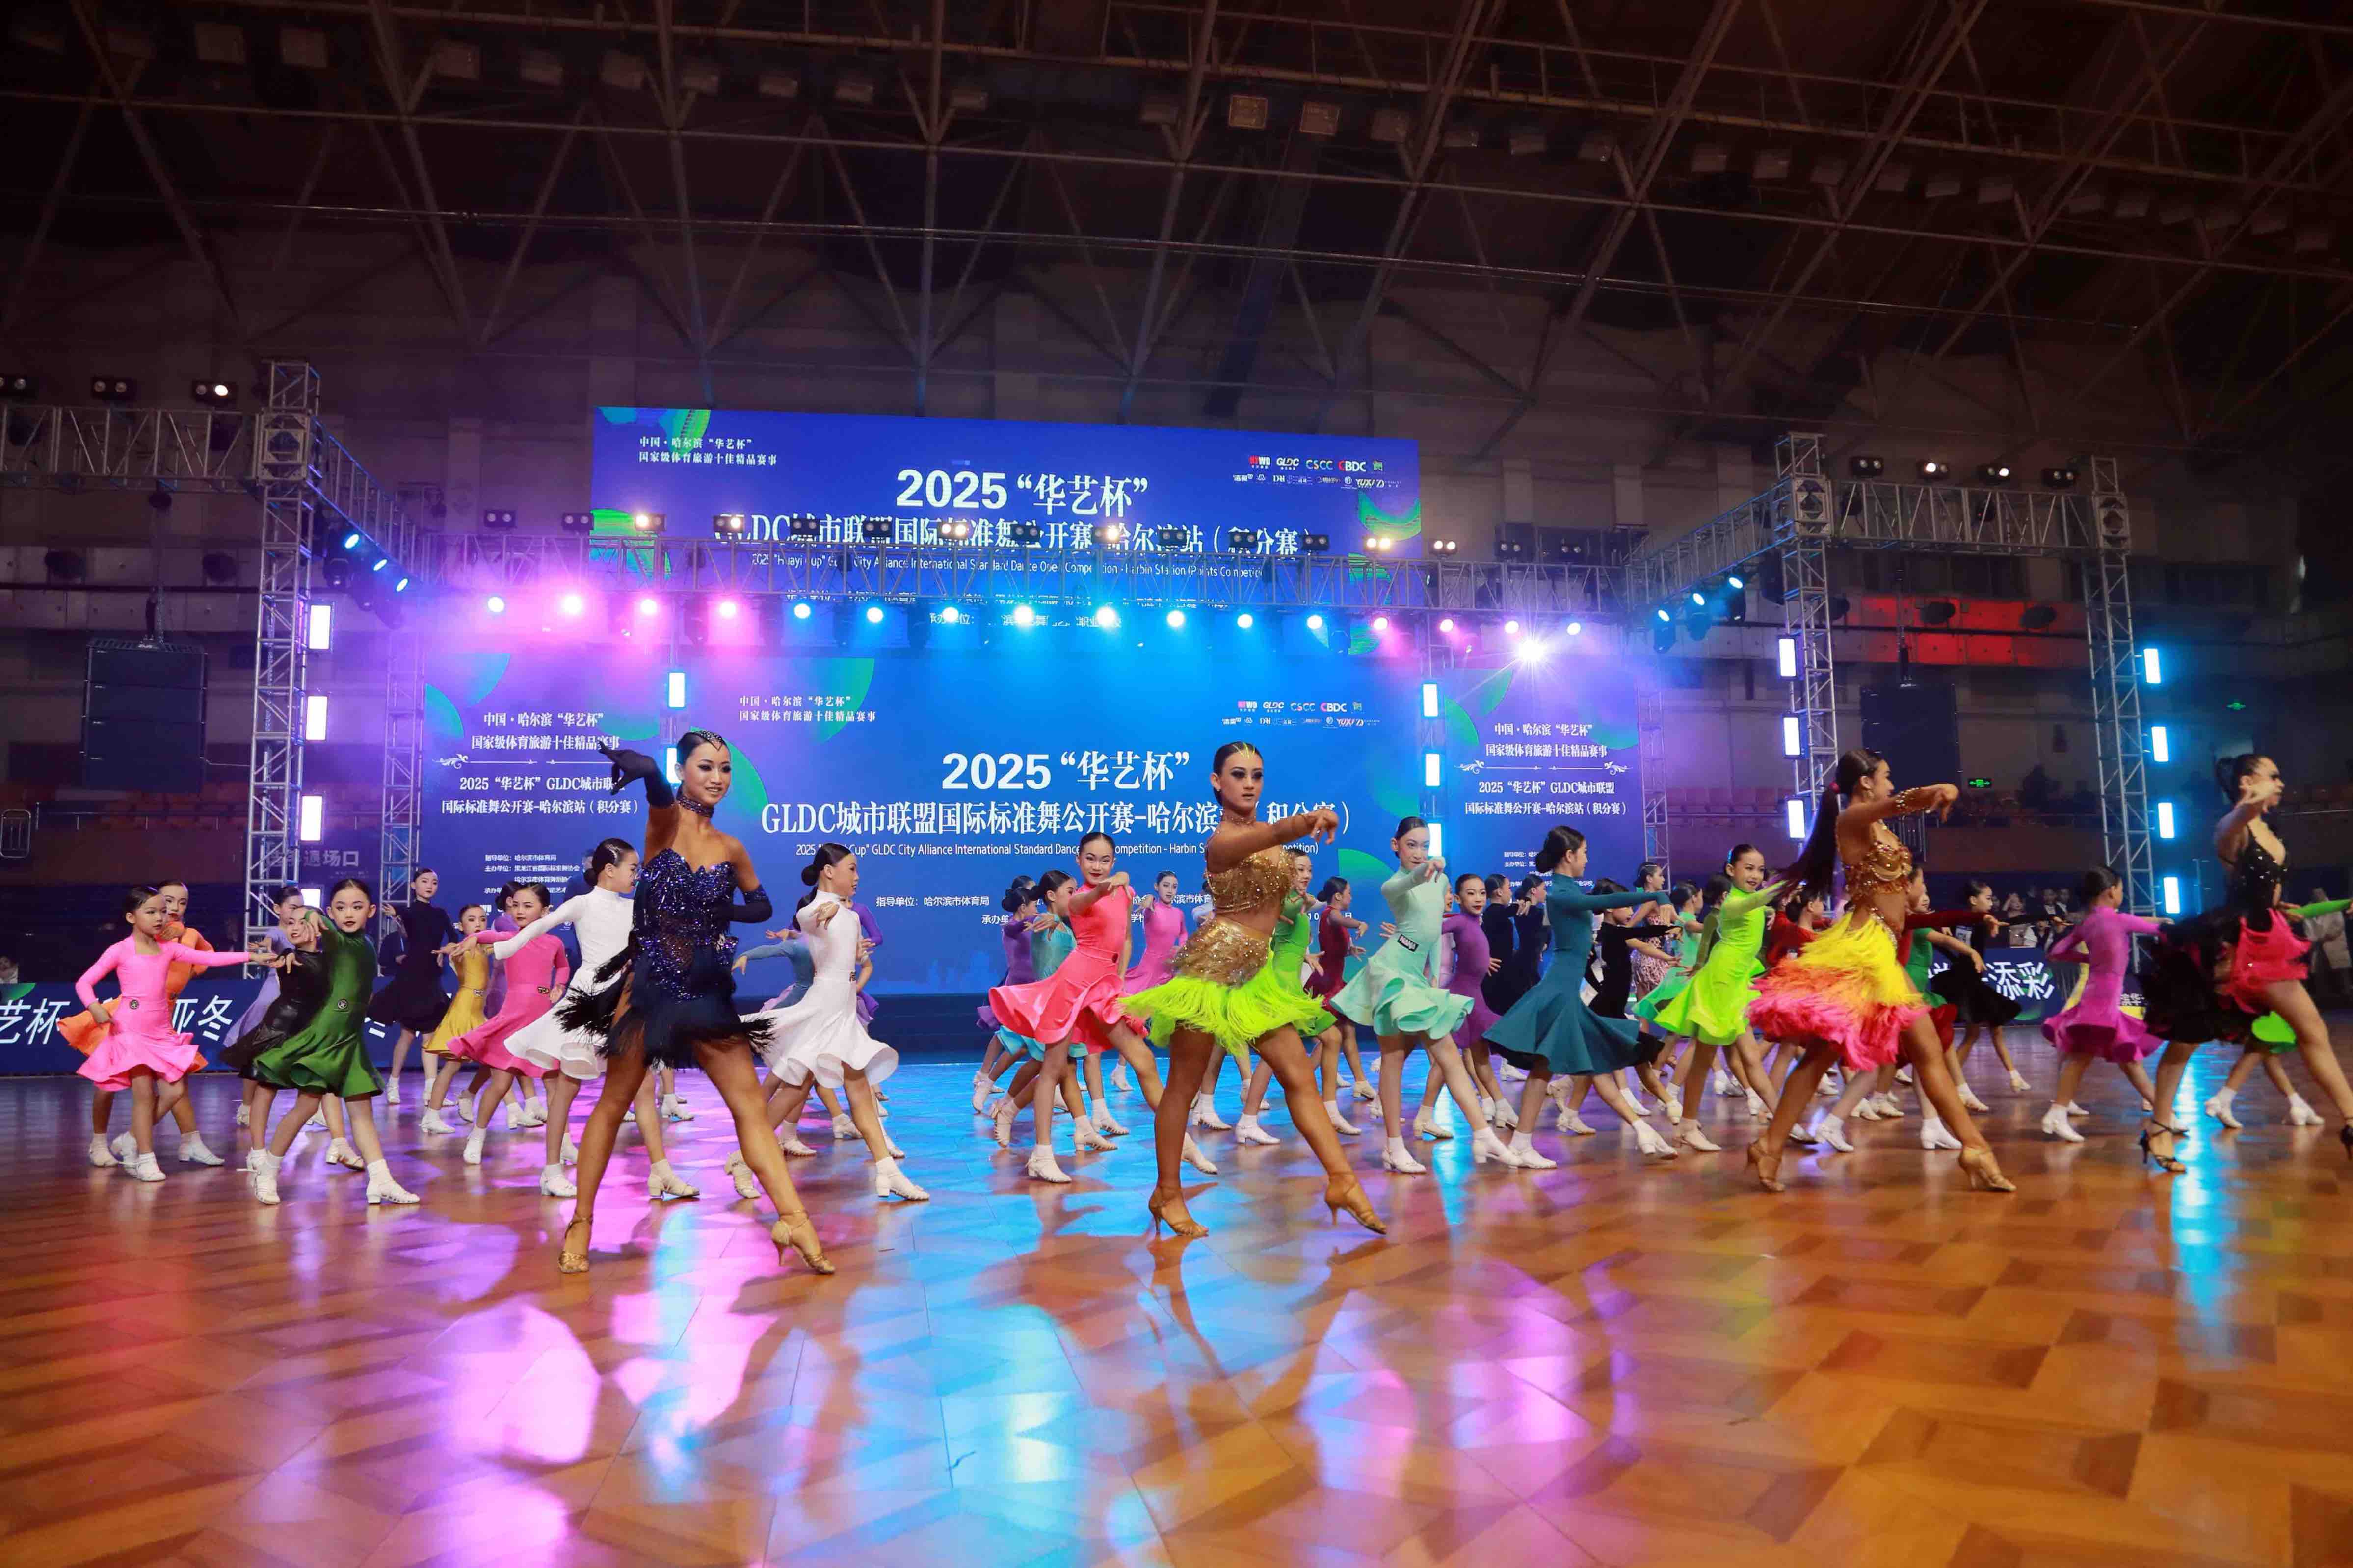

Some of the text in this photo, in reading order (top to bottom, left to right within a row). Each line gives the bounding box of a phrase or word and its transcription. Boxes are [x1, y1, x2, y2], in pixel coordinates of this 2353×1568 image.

[1276, 457, 1299, 467] GLDC
[1306, 459, 1333, 470] CSCC
[1338, 460, 1367, 472] CBDC
[896, 469, 1007, 509] 2025
[874, 557, 908, 569] Aiance
[1263, 701, 1284, 709] GLDC
[1290, 703, 1316, 712] CSCC
[1321, 702, 1347, 712] CBDC
[739, 710, 876, 722] 国家级体育旅游十佳精品赛事
[1486, 744, 1607, 758] 国家级体育旅游十佳精品赛事
[942, 753, 1051, 789] 2025
[796, 845, 816, 855] 2025
[872, 844, 896, 856] GLDC
[898, 844, 916, 858] City
[918, 844, 952, 856] Alliance
[955, 843, 1011, 856] International
[1015, 843, 1053, 855] Standard
[1115, 843, 1162, 858] ompetition
[1170, 843, 1197, 854] Harbin
[1981, 961, 2054, 1000] 添彩
